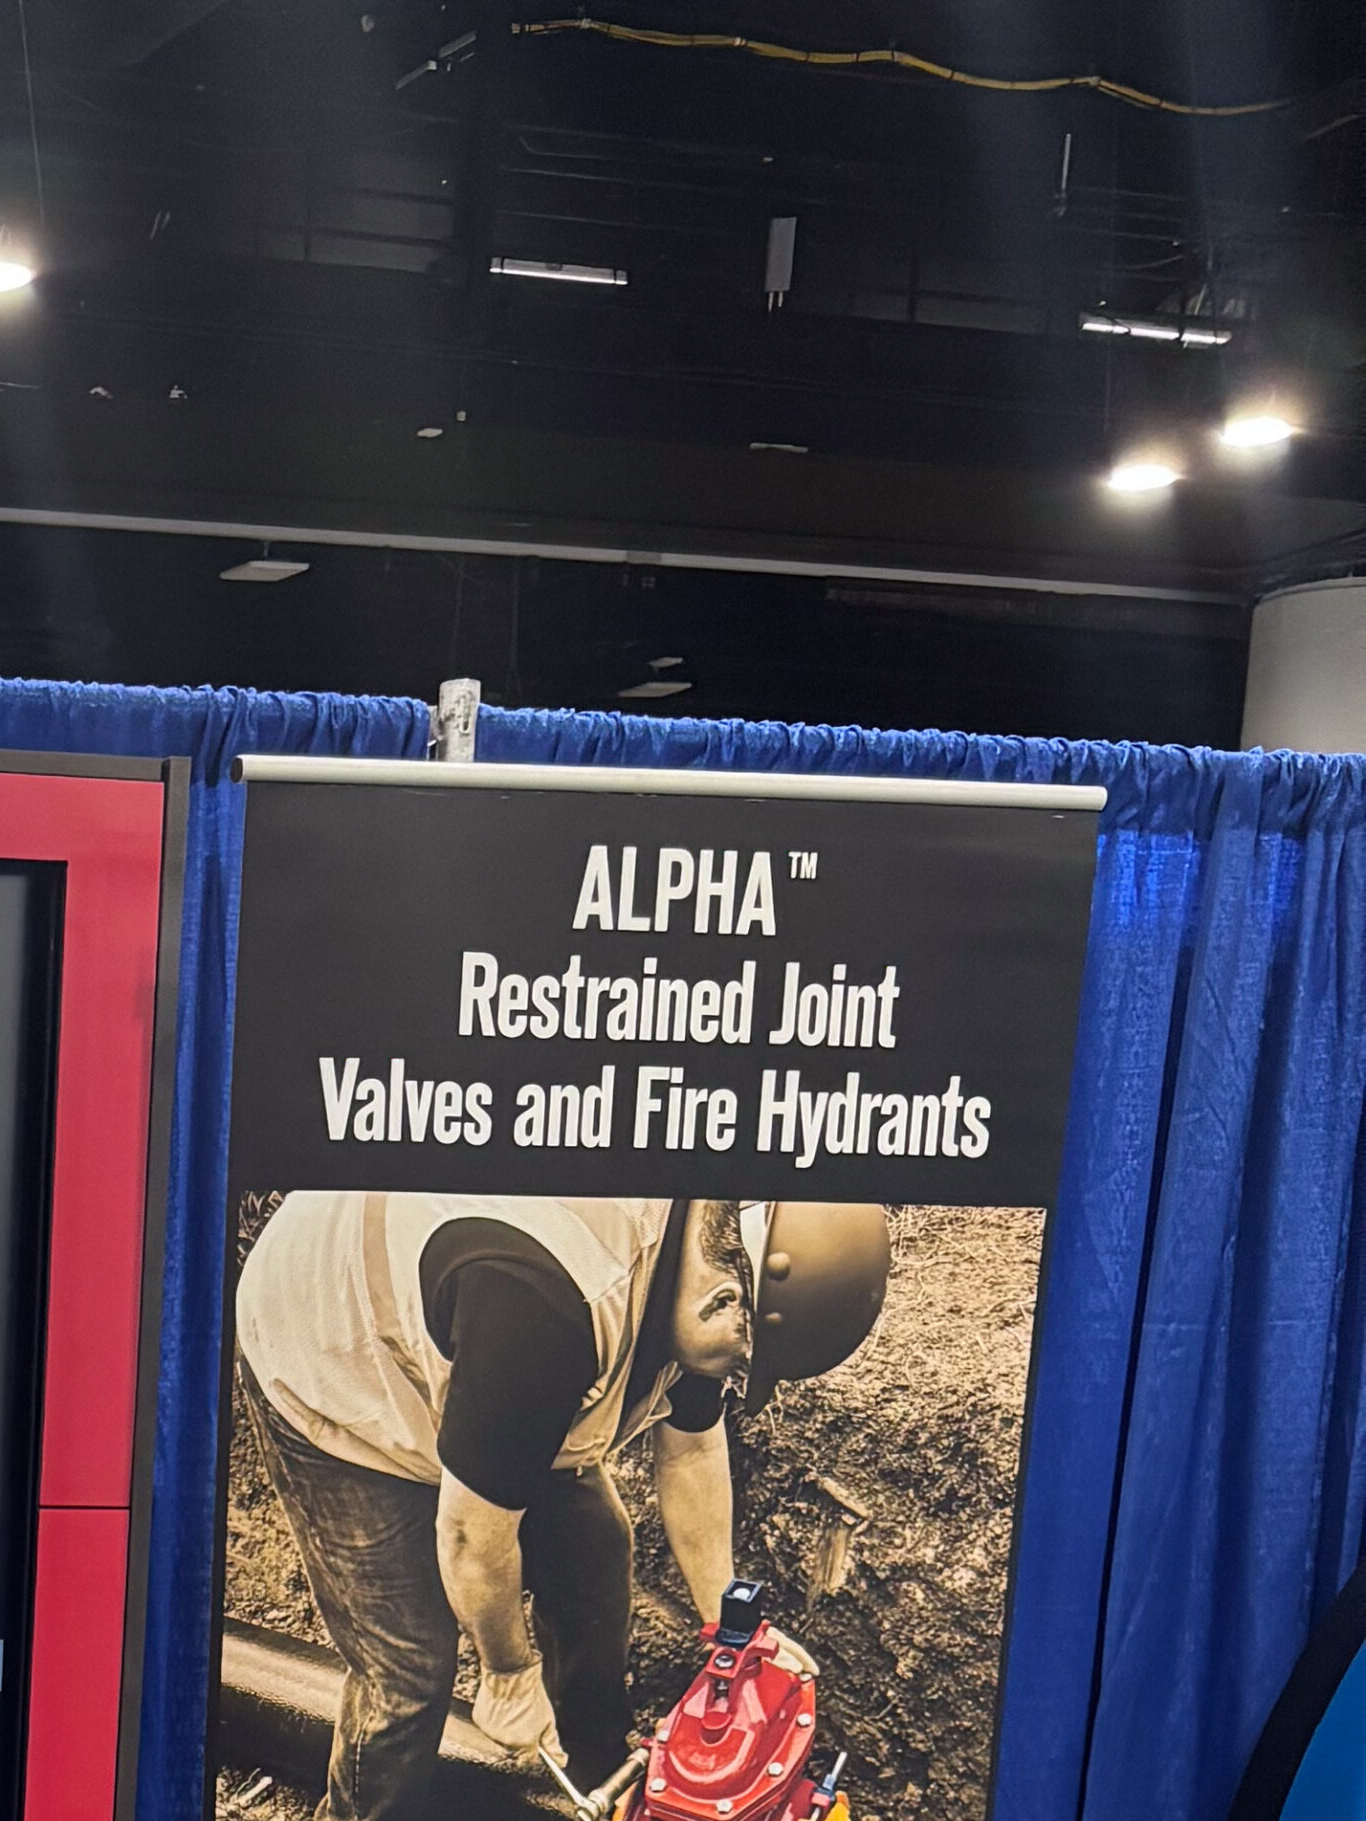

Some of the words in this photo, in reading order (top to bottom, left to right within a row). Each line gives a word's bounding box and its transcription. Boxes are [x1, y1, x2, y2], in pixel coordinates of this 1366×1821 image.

[459, 951, 756, 1044] Restrained
[769, 962, 900, 1048] Joint
[319, 1057, 492, 1146] Valves
[514, 1065, 615, 1148] and
[634, 1066, 737, 1151] Fire
[757, 1069, 991, 1168] Hydrants
